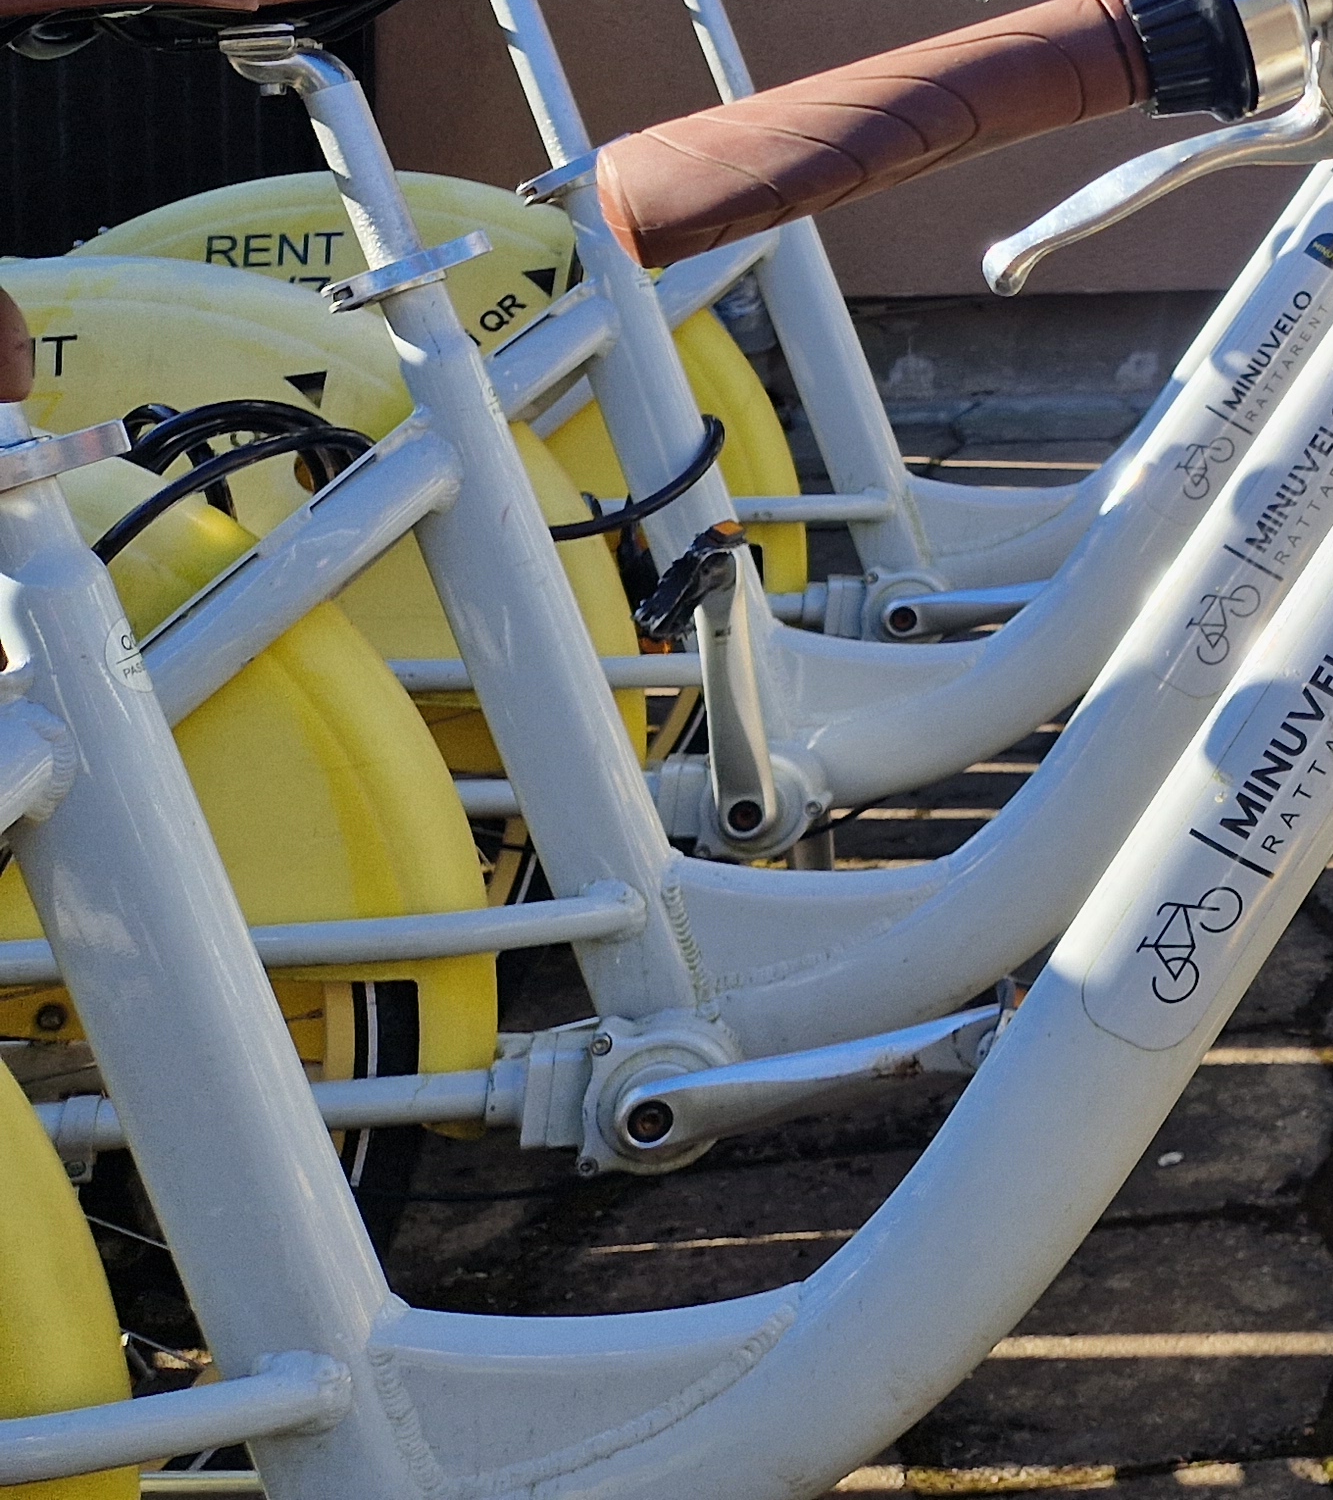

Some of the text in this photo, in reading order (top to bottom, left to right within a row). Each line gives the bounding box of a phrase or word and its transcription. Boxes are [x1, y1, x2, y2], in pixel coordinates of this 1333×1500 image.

[205, 231, 345, 267] RENT
[480, 294, 527, 332] QR
[1222, 291, 1312, 411] MINUVELO
[1245, 305, 1328, 422] RATTARENT
